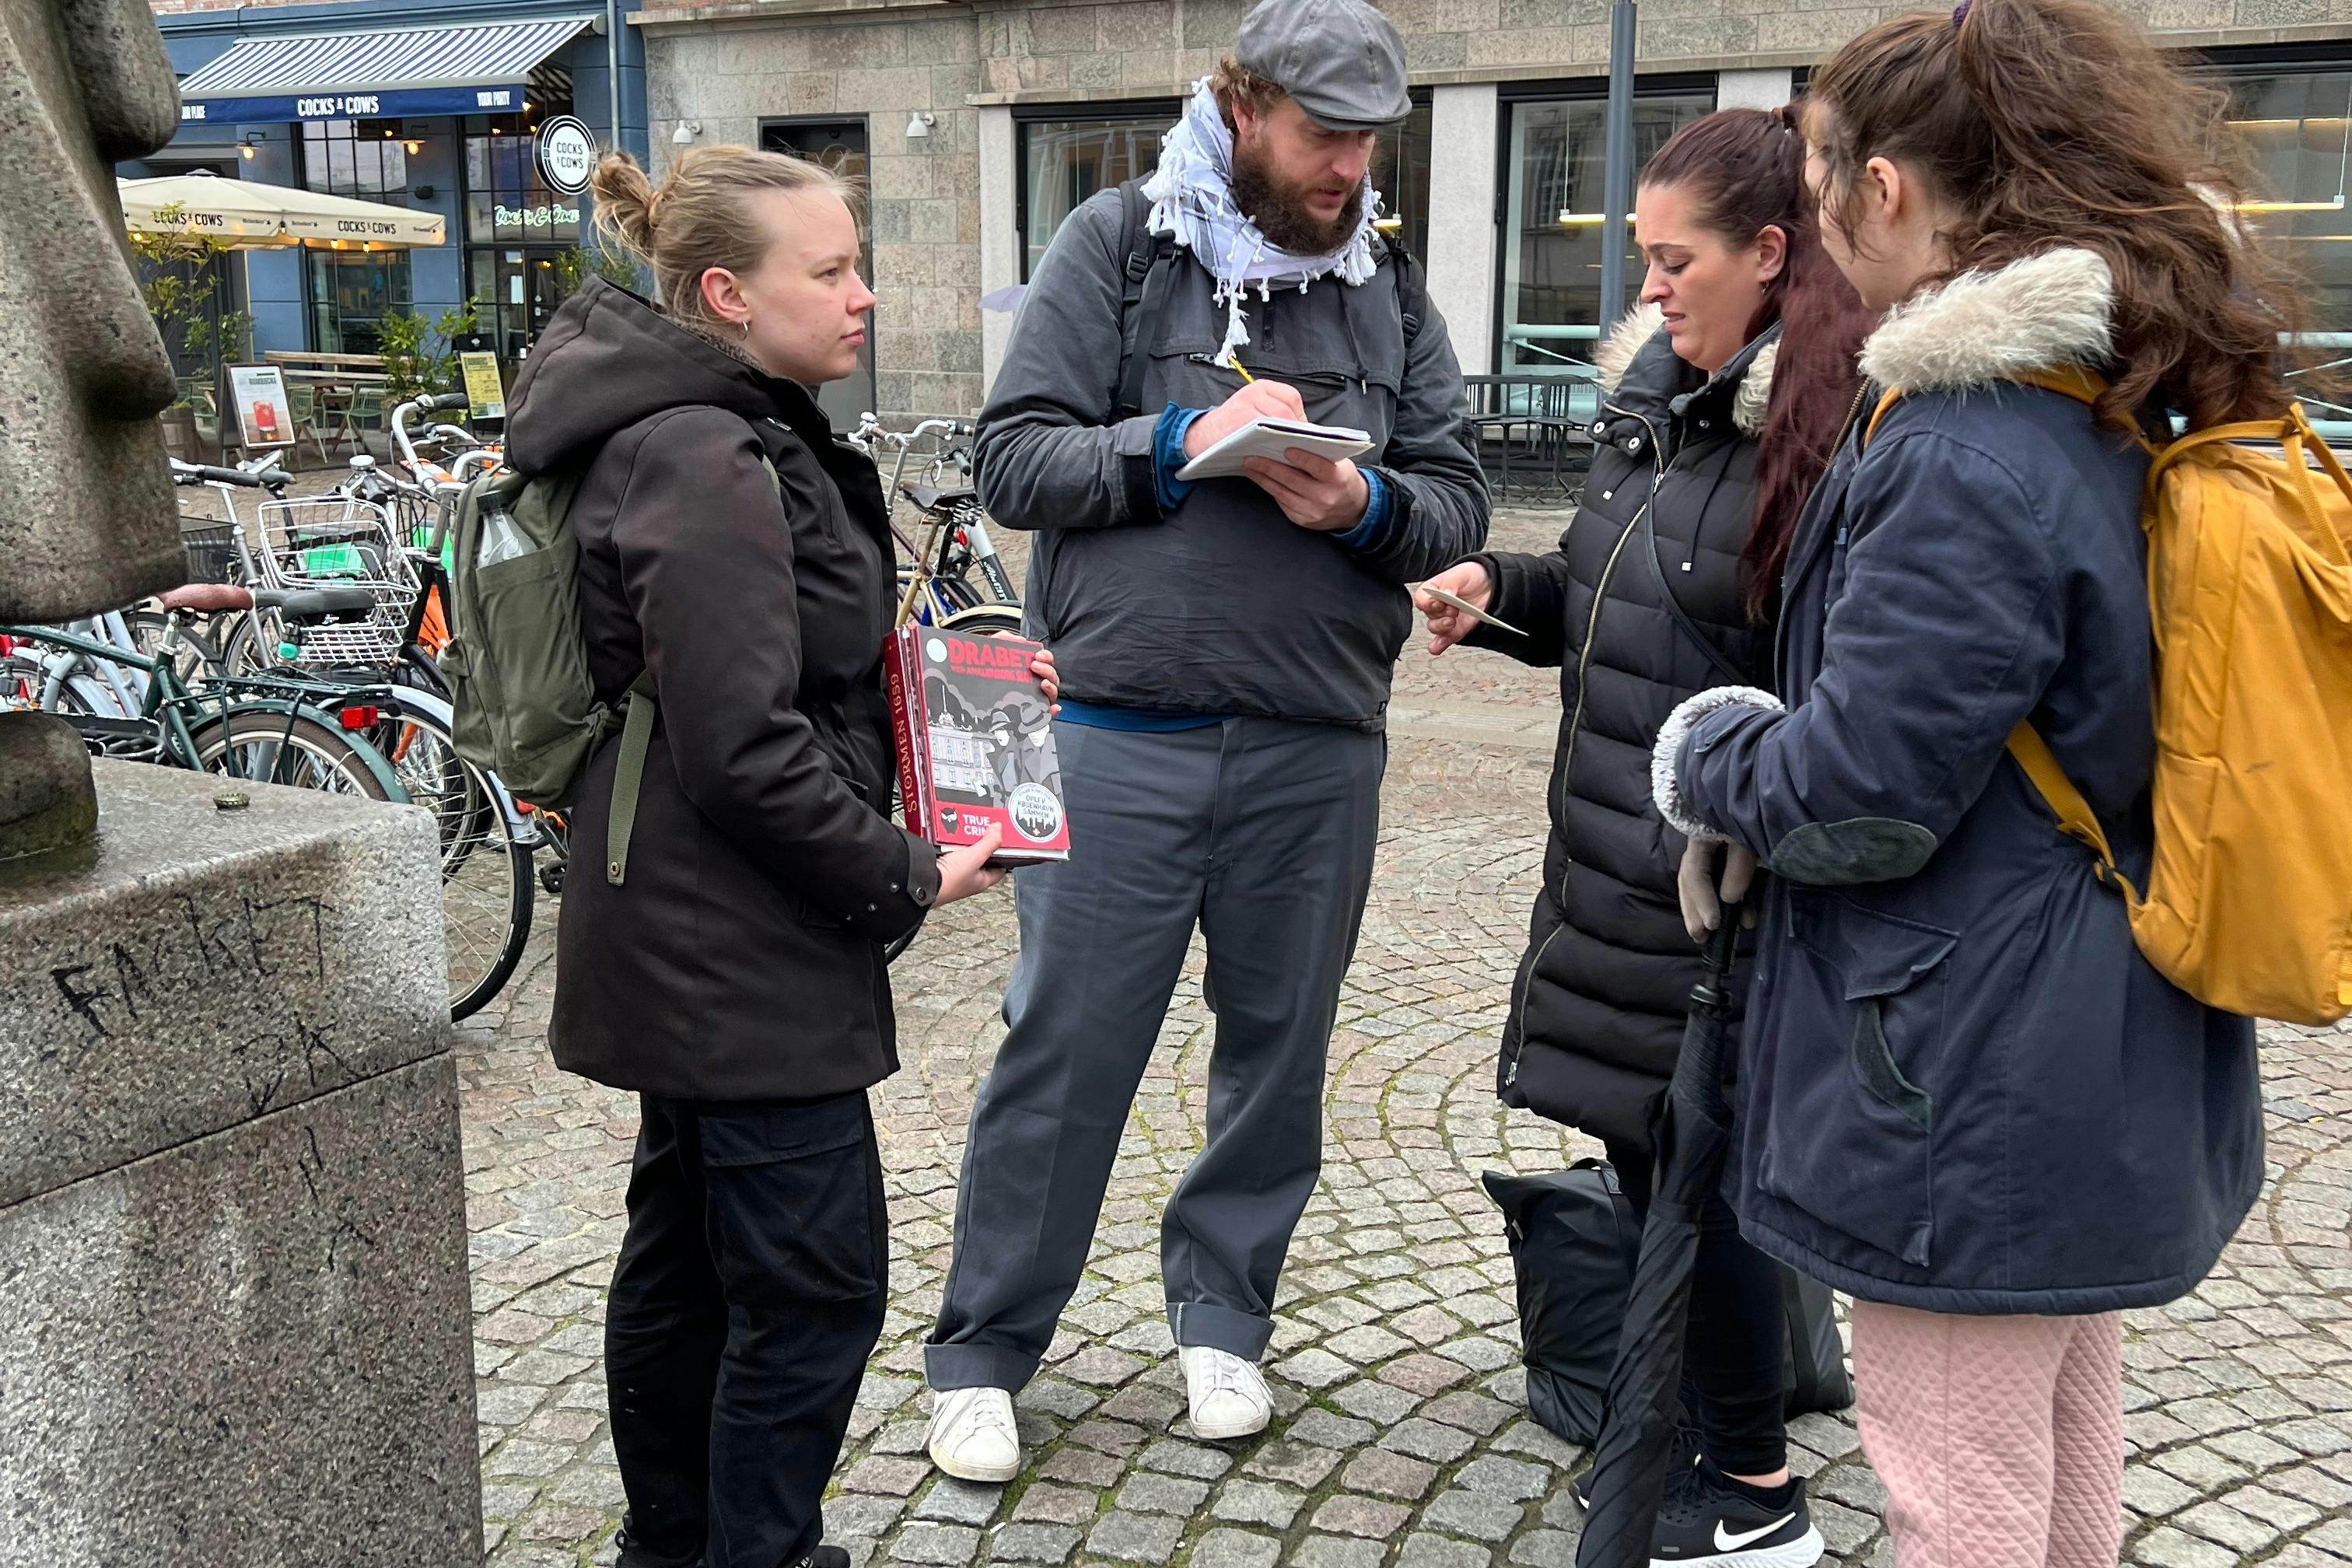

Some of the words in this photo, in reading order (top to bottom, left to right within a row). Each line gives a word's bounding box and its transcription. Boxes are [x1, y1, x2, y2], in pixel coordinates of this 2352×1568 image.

[297, 97, 335, 117] COCKS
[345, 95, 380, 114] COWS
[477, 91, 492, 107] YOUR
[492, 90, 510, 106] PARTY
[556, 142, 583, 155] COCKS
[561, 156, 584, 170] COWS
[194, 213, 223, 226] COWS
[534, 206, 551, 227] &
[338, 220, 366, 233] COCKS
[373, 222, 397, 235] COWS
[947, 637, 1035, 668] DRABET
[890, 674, 903, 715] 1659
[896, 719, 918, 814] STORMEN
[962, 814, 990, 827] TRUE
[1023, 808, 1049, 818] SAMMEN
[964, 824, 988, 837] CRI
